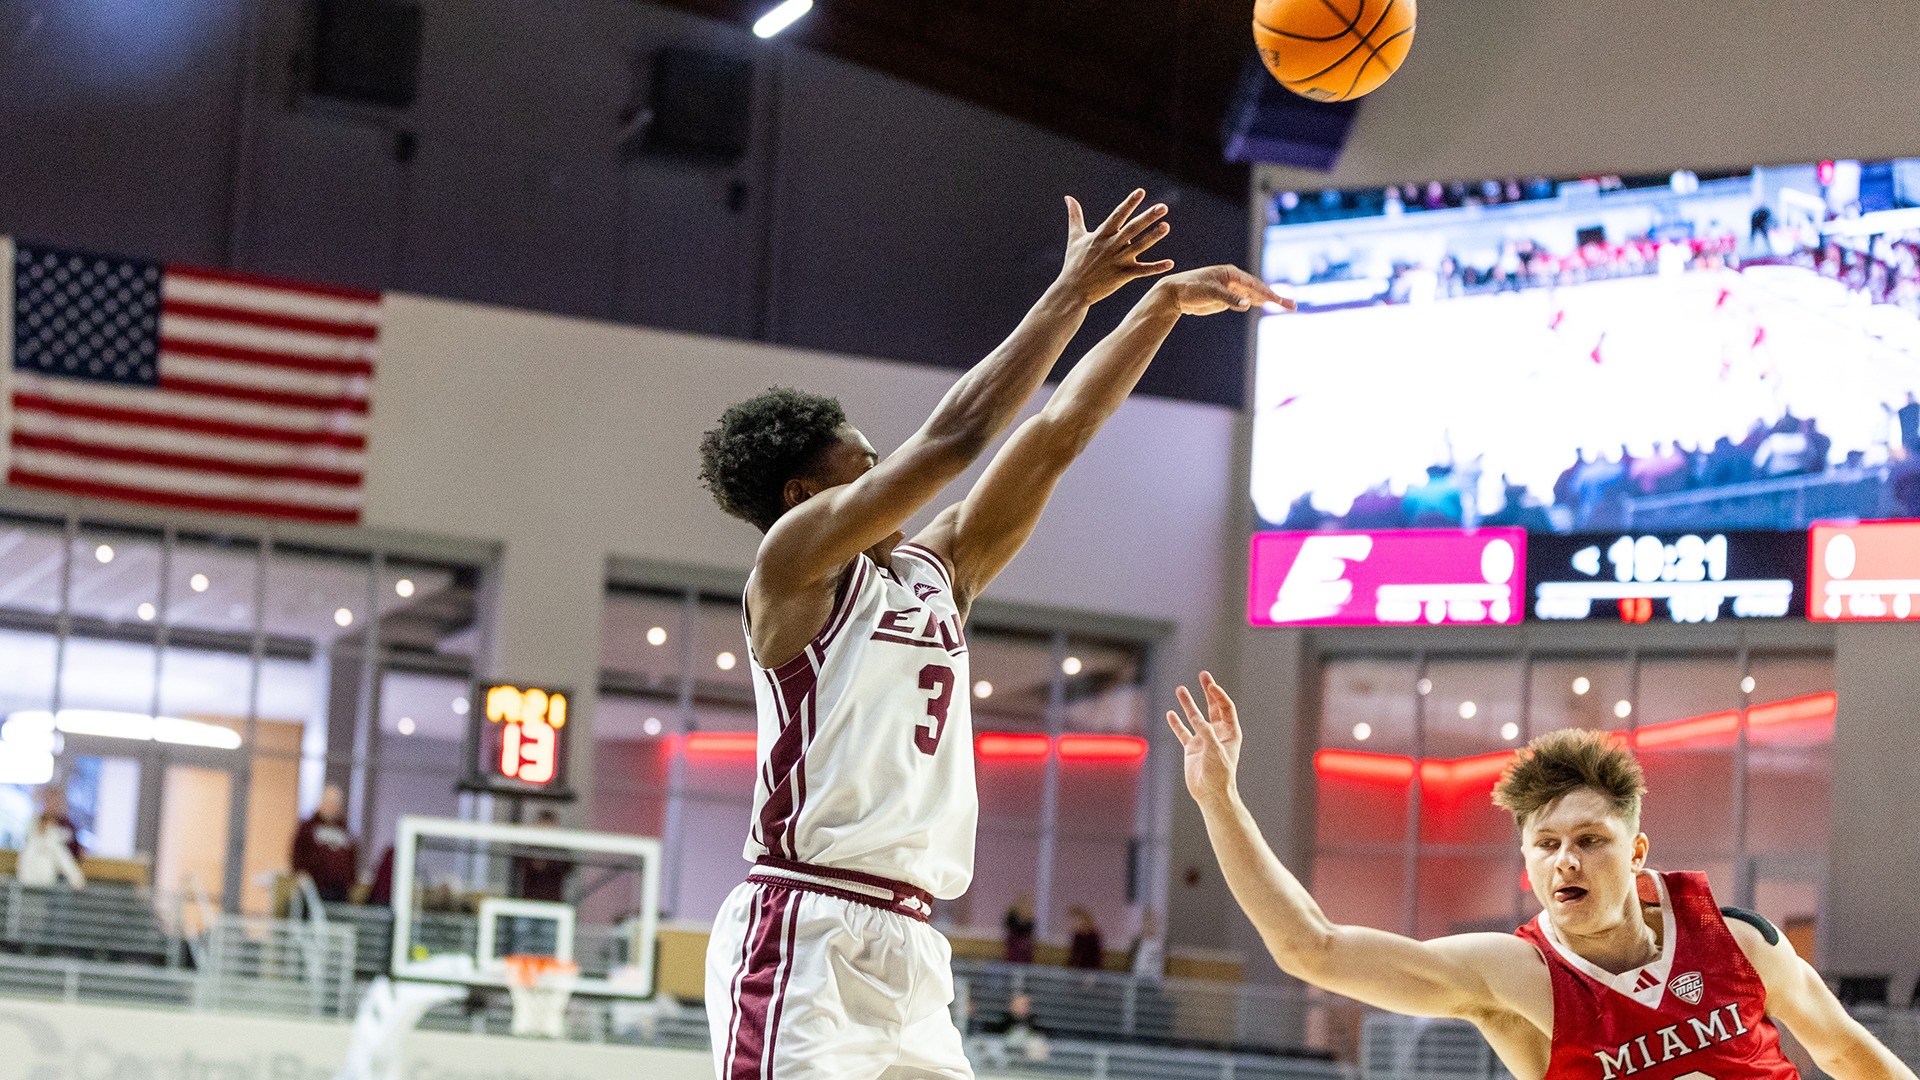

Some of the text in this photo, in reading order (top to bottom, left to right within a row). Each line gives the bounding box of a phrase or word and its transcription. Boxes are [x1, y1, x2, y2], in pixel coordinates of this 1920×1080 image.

[914, 663, 955, 756] 3
[501, 722, 555, 784] 13
[1675, 979, 1702, 996] MAC
[1594, 1003, 1748, 1080] MIAMI
